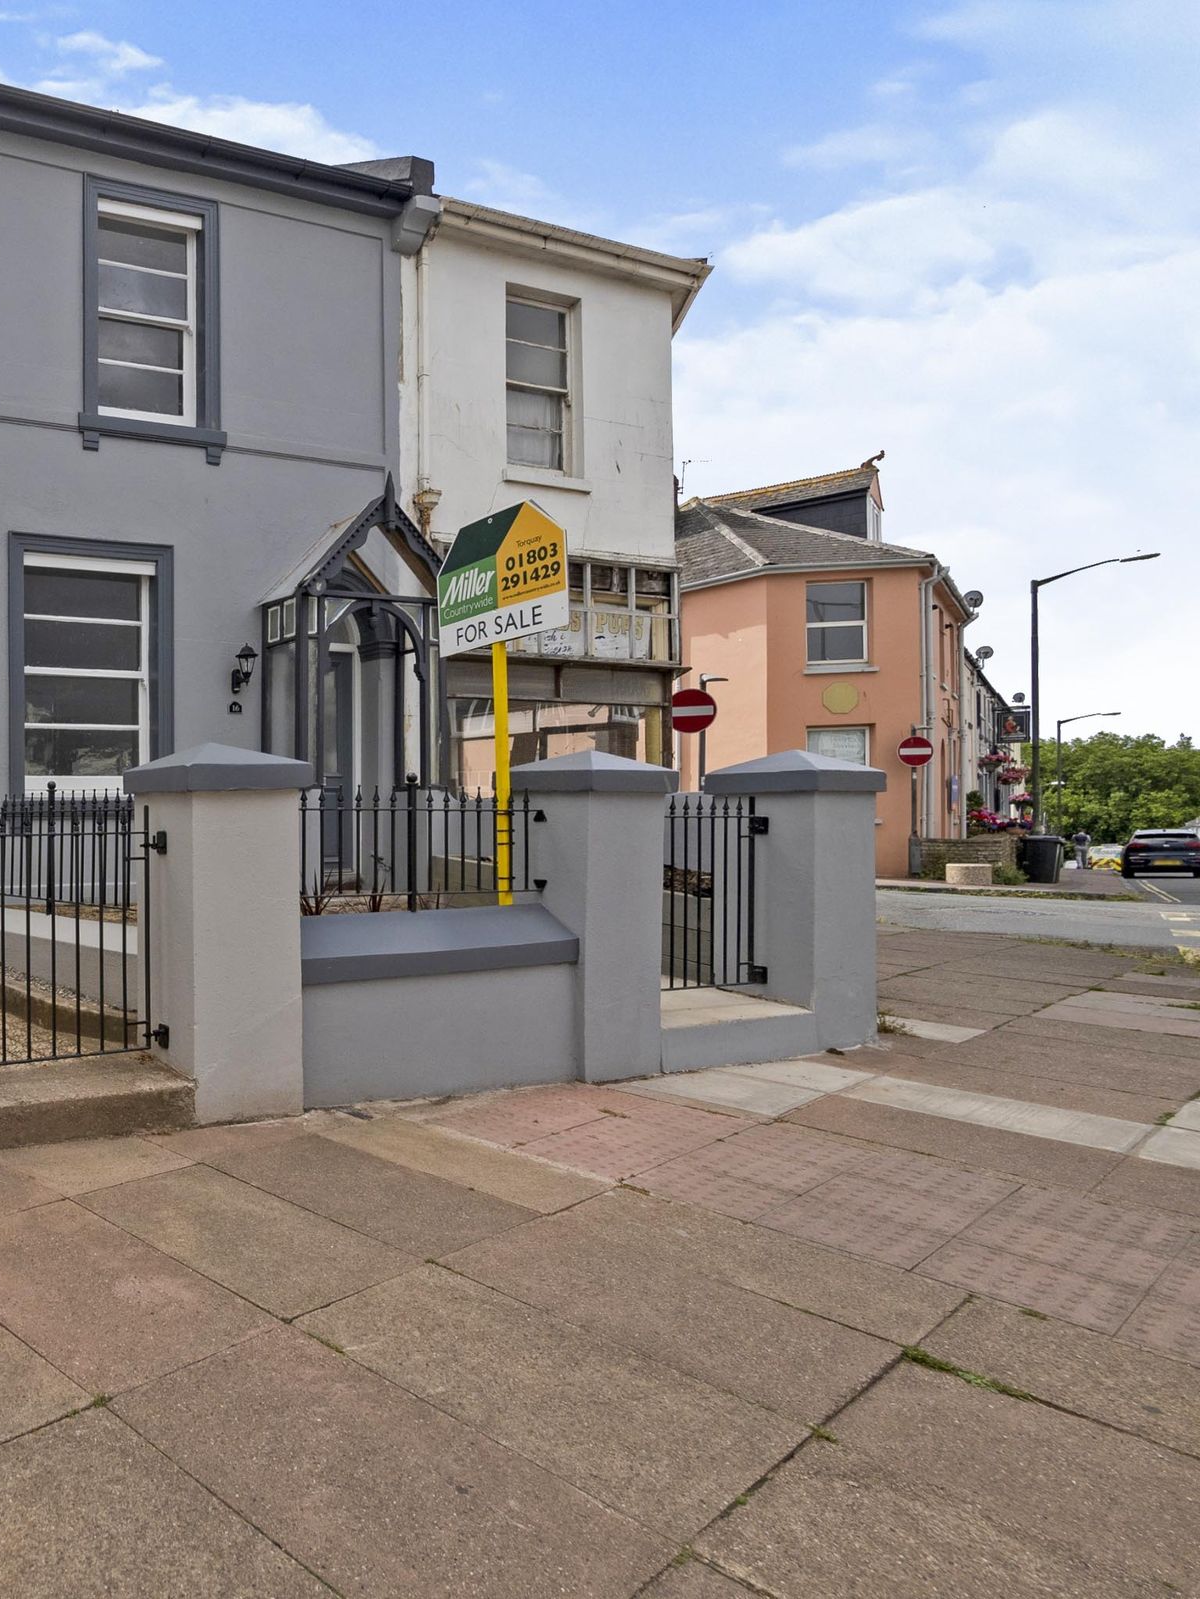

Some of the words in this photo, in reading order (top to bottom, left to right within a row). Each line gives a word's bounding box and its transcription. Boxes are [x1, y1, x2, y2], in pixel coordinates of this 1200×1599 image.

[505, 542, 558, 571] 01803
[516, 535, 542, 548] Torquay
[440, 567, 496, 609] Miller
[501, 561, 561, 592] 291429
[443, 595, 494, 620] Countrywide
[456, 621, 488, 647] FOR
[494, 605, 543, 635] SALE
